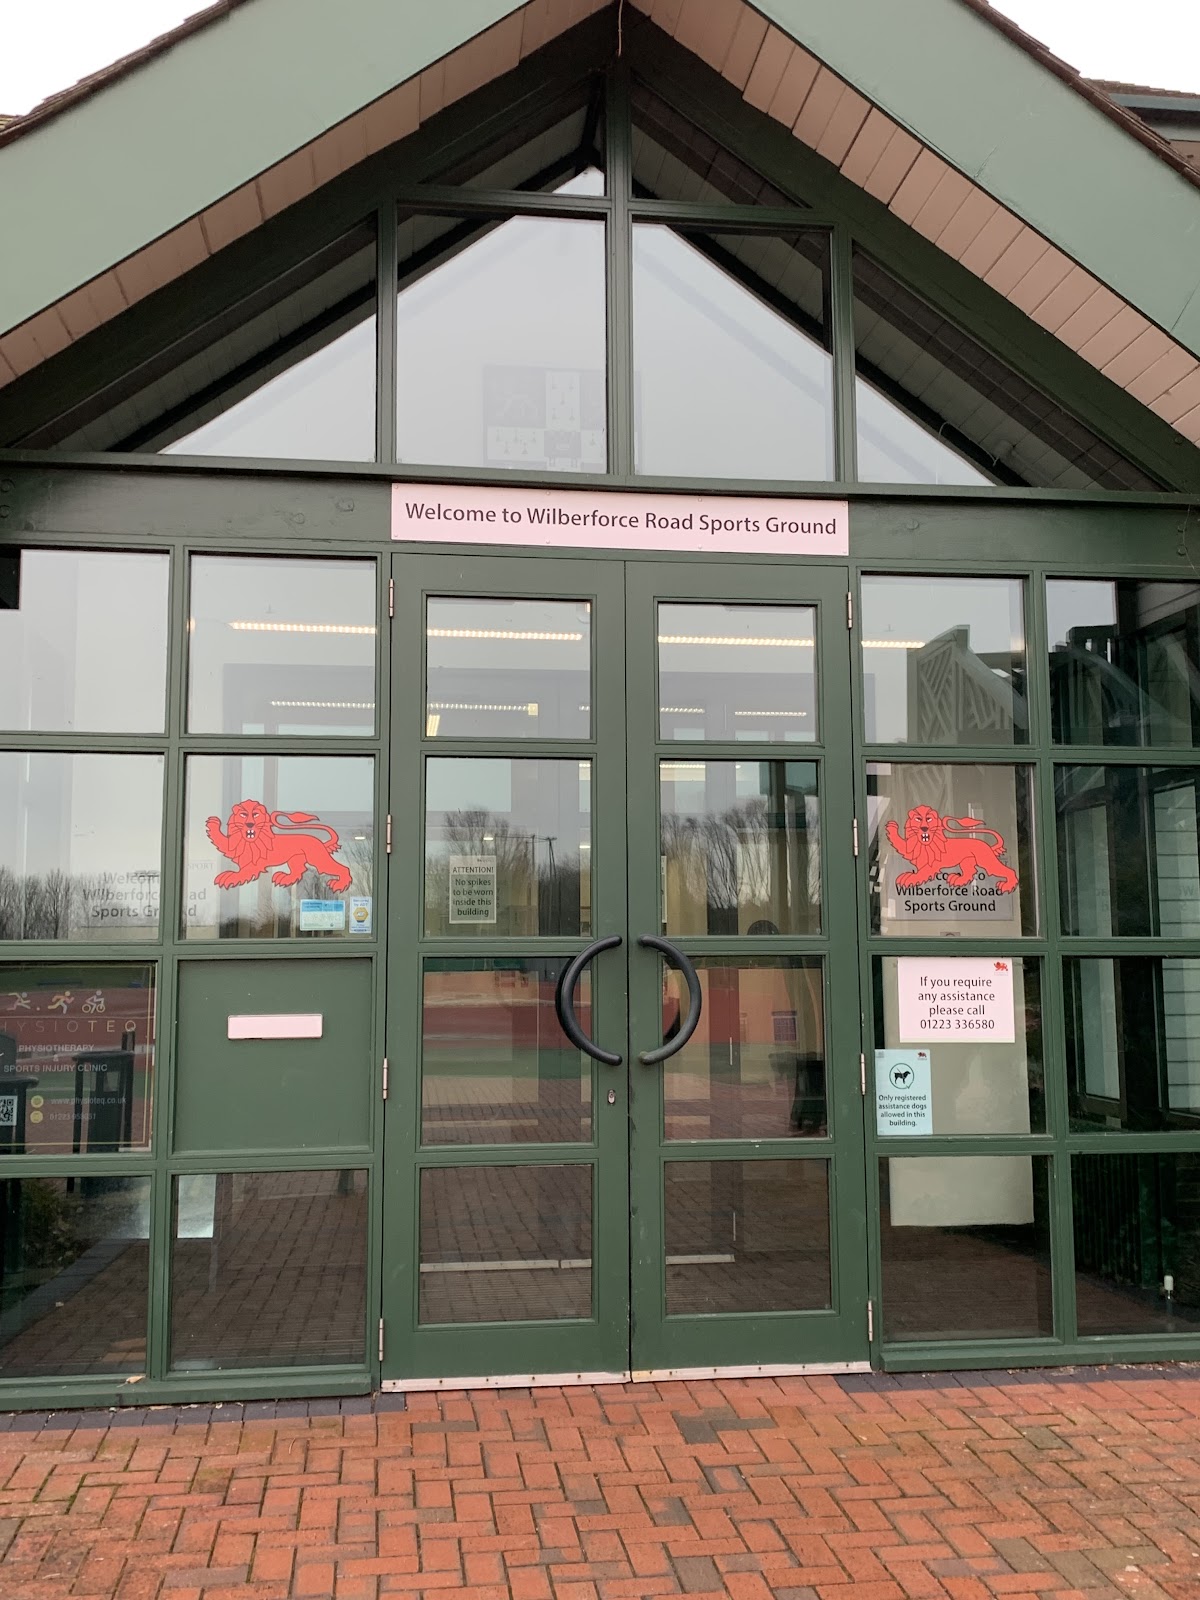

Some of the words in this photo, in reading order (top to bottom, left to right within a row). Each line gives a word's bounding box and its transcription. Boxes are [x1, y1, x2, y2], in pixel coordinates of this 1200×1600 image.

[405, 502, 497, 523] Welcome
[502, 508, 522, 524] to
[527, 507, 640, 529] Wilberforce
[645, 512, 694, 531] Road
[699, 513, 760, 537] Sports
[765, 517, 837, 536] Ground
[452, 866, 494, 874] ATTENTION!
[103, 872, 160, 885] Welcom
[467, 879, 491, 888] spikes
[83, 888, 160, 901] Wilberforc
[896, 884, 968, 896] Wilberforce
[453, 898, 476, 906] inside
[477, 898, 492, 906] this
[905, 900, 945, 914] Sports
[948, 900, 996, 912] Ground
[91, 906, 138, 920] Sports
[457, 908, 489, 917] building
[920, 976, 928, 987] If
[930, 979, 950, 989] you
[953, 976, 992, 989] require
[918, 992, 938, 1003] any
[940, 991, 995, 1001] assistance
[929, 1005, 964, 1017] please
[966, 1005, 985, 1015] call
[920, 1019, 952, 1030] 01223
[955, 1019, 995, 1030] 336580
[18, 1044, 95, 1052] PHYSIOTHERAPY
[3, 1064, 40, 1072] SPORTS
[42, 1064, 75, 1072] INJURY
[77, 1063, 108, 1072] CLINIC
[878, 1094, 894, 1102] Only
[894, 1094, 927, 1103] registered
[911, 1103, 927, 1111] dogs
[889, 1119, 918, 1127] building.
